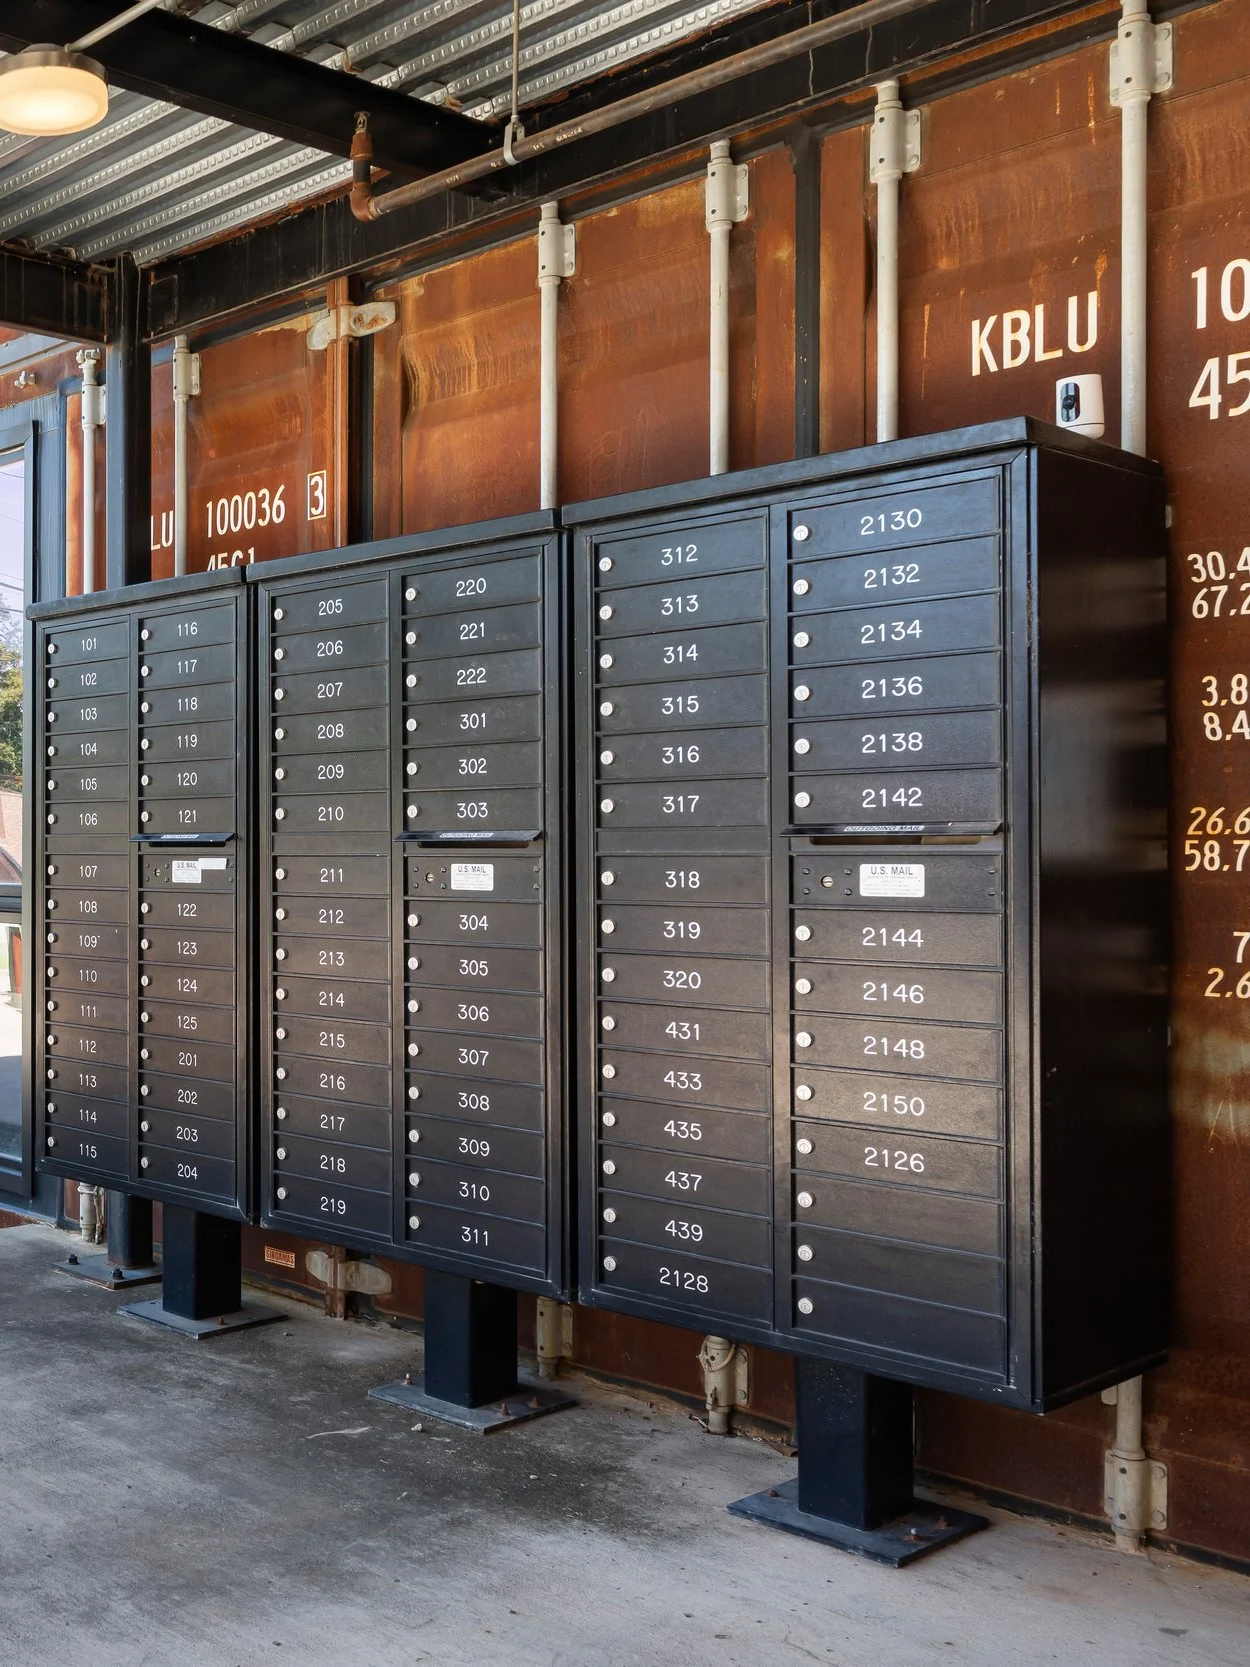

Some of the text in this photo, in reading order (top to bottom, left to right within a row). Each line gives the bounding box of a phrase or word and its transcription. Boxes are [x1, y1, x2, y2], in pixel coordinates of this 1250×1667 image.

[970, 258, 1250, 377] KBLU 10
[206, 483, 286, 539] 100036
[309, 475, 324, 516] 3
[860, 508, 923, 536] 2130
[661, 544, 699, 566] 312
[863, 563, 921, 589] 2132
[456, 577, 487, 597] 220
[318, 598, 343, 616] 205
[661, 594, 699, 616] 313
[177, 621, 198, 637] 116
[459, 621, 485, 641] 221
[860, 619, 923, 644] 2134
[81, 637, 97, 652] 101
[316, 639, 344, 657] 206
[663, 643, 699, 665] 314
[177, 659, 198, 674] 117
[80, 672, 98, 686] 102
[456, 667, 487, 686] 222
[317, 681, 343, 699] 207
[861, 675, 923, 699] 2136
[177, 696, 198, 712] 118
[661, 695, 700, 715] 315
[80, 707, 98, 721] 103
[459, 712, 486, 730] 301
[317, 723, 344, 740] 208
[80, 742, 98, 756] 104
[177, 734, 198, 748] 119
[861, 731, 923, 754] 2138
[661, 745, 700, 765] 316
[317, 764, 345, 780] 209
[458, 757, 488, 775] 302
[80, 777, 98, 791] 105
[177, 771, 198, 786] 120
[662, 795, 700, 814] 317
[862, 786, 923, 808] 2142
[79, 812, 98, 826] 106
[178, 809, 197, 823] 121
[318, 806, 344, 822] 210
[456, 802, 489, 819] 303
[79, 865, 98, 878] 107
[320, 867, 343, 883] 211
[457, 865, 487, 873] U.S. MAIL
[870, 866, 914, 876] U.S. MAIL
[665, 870, 700, 889] 318
[79, 900, 98, 914] 108
[177, 903, 198, 917] 122
[318, 908, 344, 924] 212
[459, 914, 489, 931] 304
[663, 920, 701, 940] 319
[79, 934, 98, 948] 109
[862, 926, 924, 948] 2144
[177, 941, 198, 955] 123
[1233, 931, 1250, 964] 7
[318, 950, 345, 967] 213
[79, 969, 98, 983] 110
[459, 959, 489, 977] 305
[177, 977, 198, 993] 124
[663, 970, 702, 990] 320
[318, 990, 345, 1008] 214
[862, 981, 925, 1004] 2146
[80, 1004, 96, 1018] 111
[457, 1004, 490, 1022] 306
[177, 1015, 198, 1030] 125
[665, 1021, 700, 1041] 431
[79, 1038, 97, 1054] 112
[319, 1031, 345, 1049] 215
[863, 1035, 925, 1060] 2148
[178, 1051, 197, 1067] 201
[458, 1048, 489, 1066] 307
[79, 1073, 97, 1088] 113
[319, 1073, 346, 1091] 216
[663, 1070, 702, 1091] 433
[177, 1088, 198, 1105] 202
[458, 1092, 490, 1111] 308
[863, 1091, 925, 1117] 2150
[79, 1108, 97, 1124] 114
[320, 1113, 346, 1132] 217
[176, 1125, 199, 1143] 203
[663, 1119, 703, 1141] 435
[79, 1143, 97, 1159] 115
[458, 1137, 490, 1157] 309
[320, 1154, 346, 1173] 218
[864, 1146, 925, 1173] 2126
[177, 1163, 198, 1180] 204
[664, 1170, 703, 1192] 437
[459, 1181, 490, 1202] 310
[320, 1196, 346, 1215] 219
[461, 1226, 488, 1246] 311
[664, 1219, 703, 1242] 439
[659, 1267, 709, 1293] 2128
